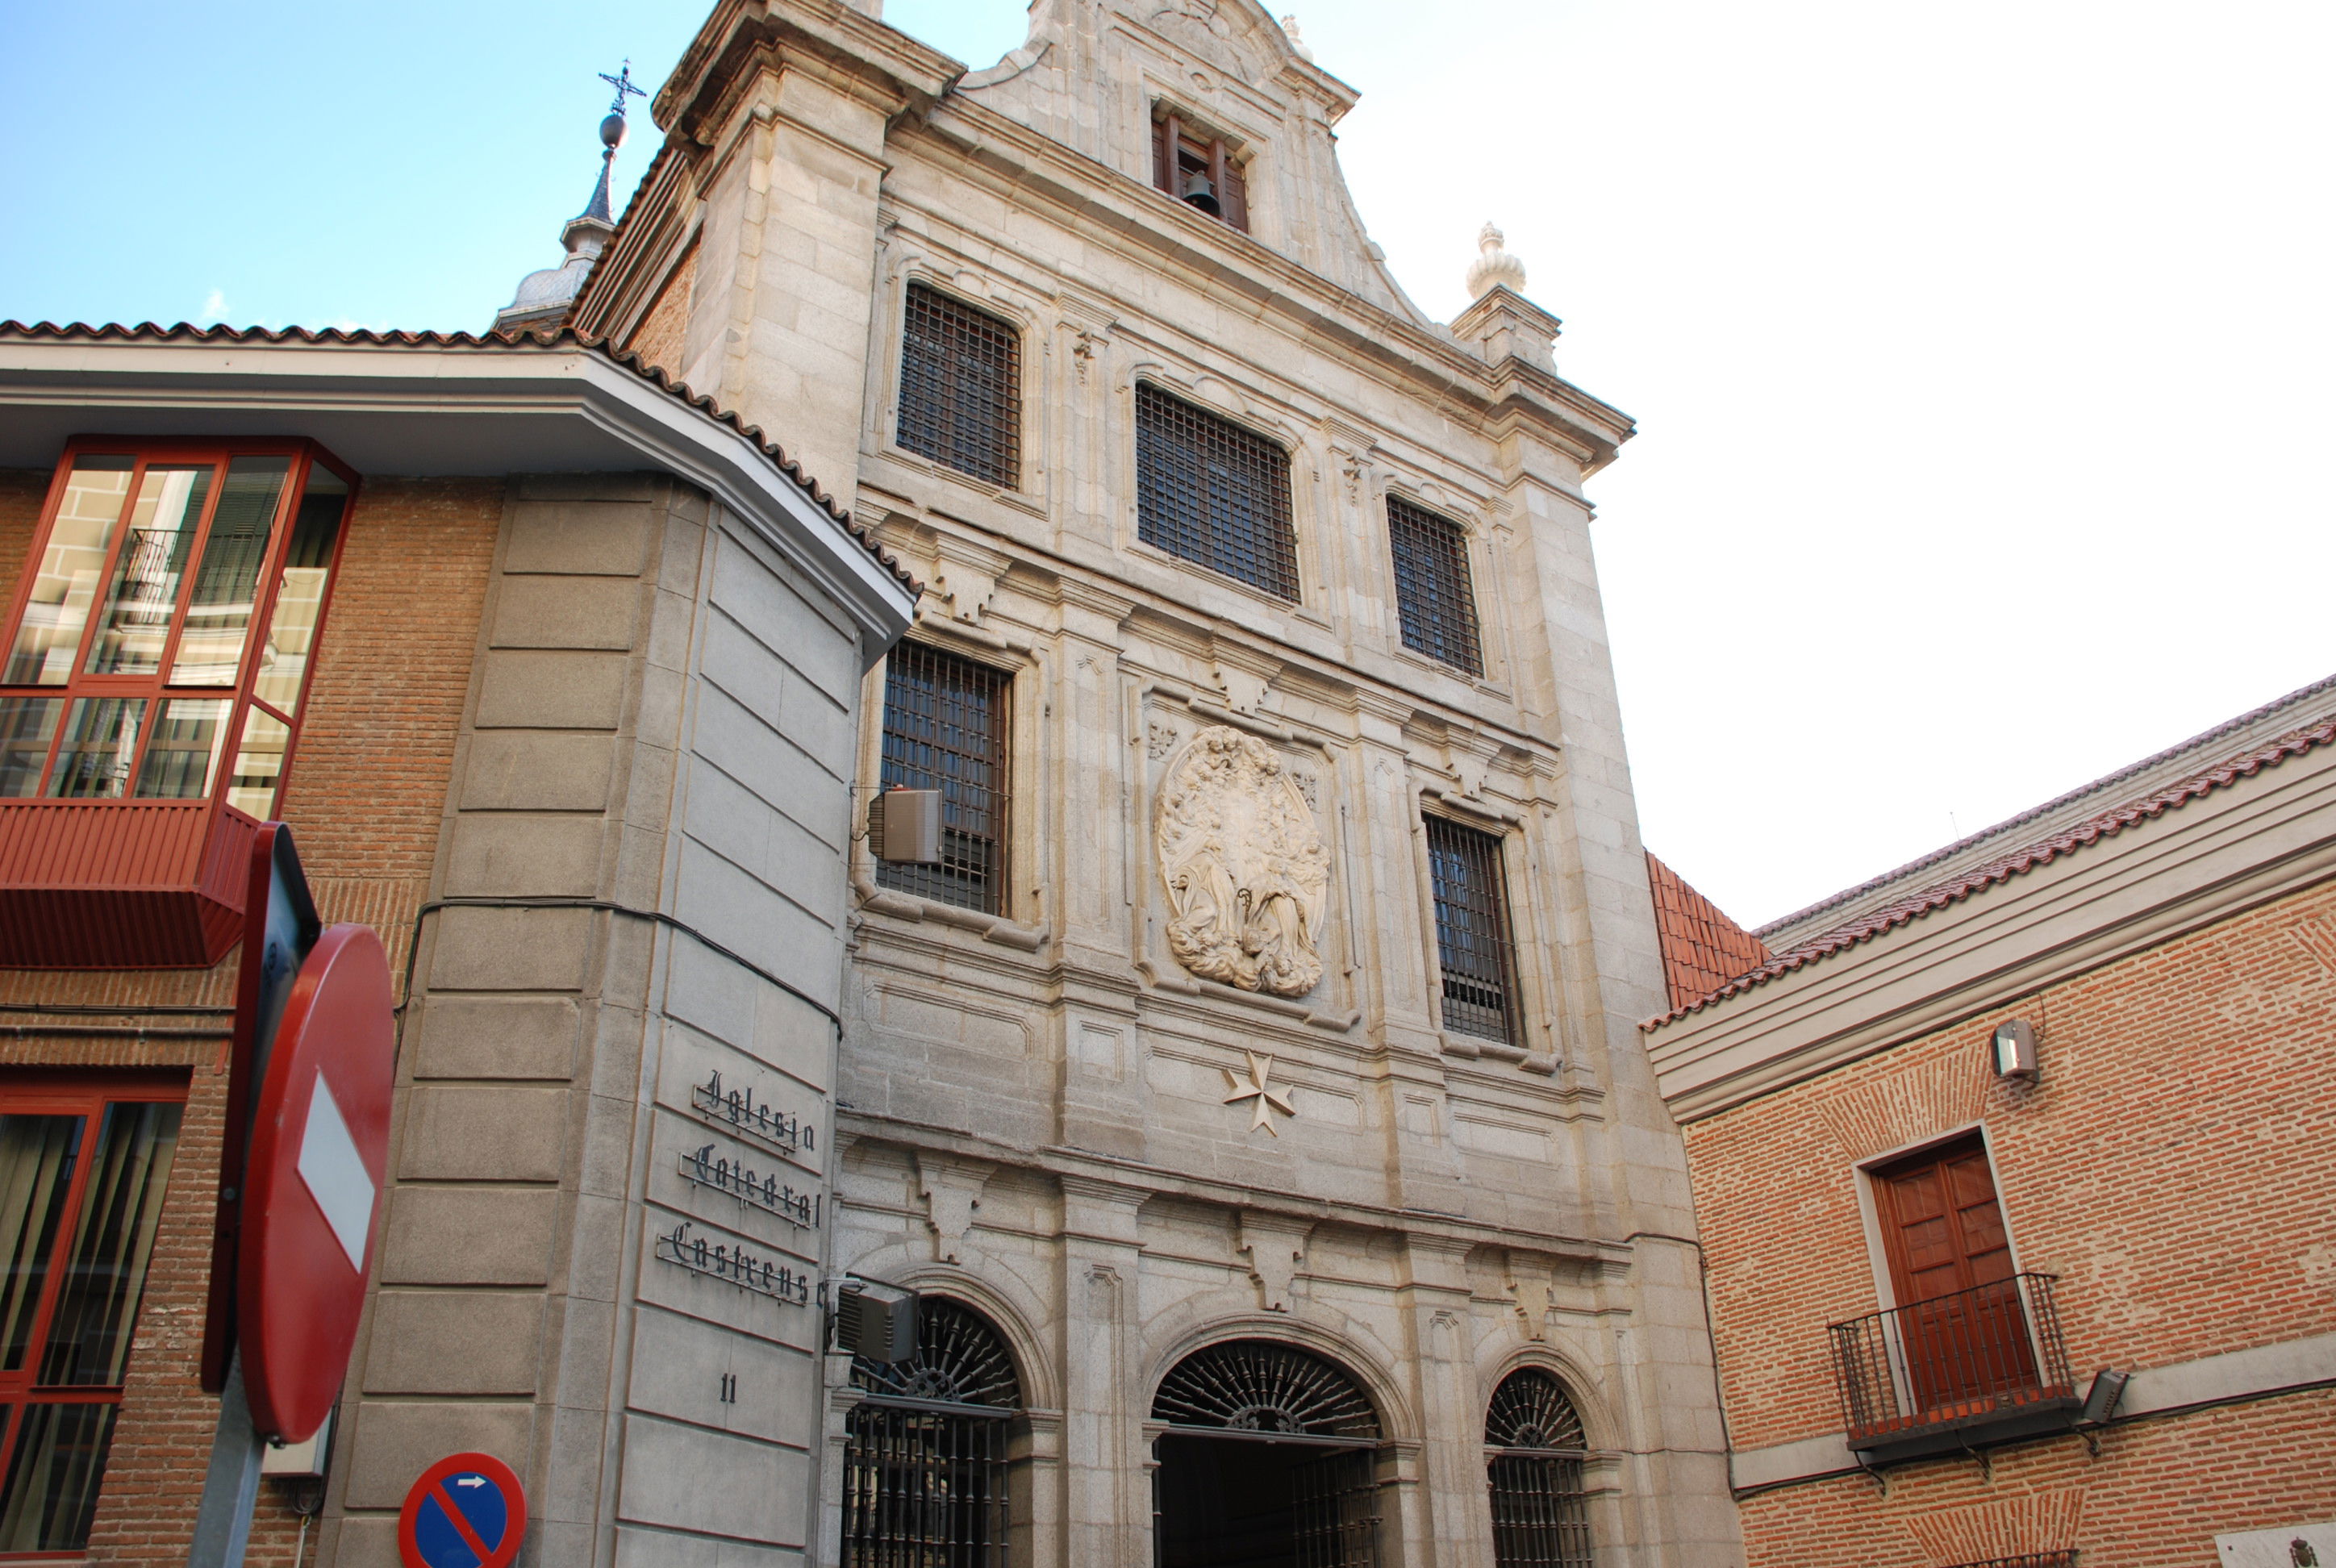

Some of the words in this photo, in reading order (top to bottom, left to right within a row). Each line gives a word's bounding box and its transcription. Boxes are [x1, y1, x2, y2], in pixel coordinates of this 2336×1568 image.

[706, 1069, 815, 1151] Iglesia
[695, 1143, 821, 1229] Catedral
[672, 1221, 828, 1309] Castrense
